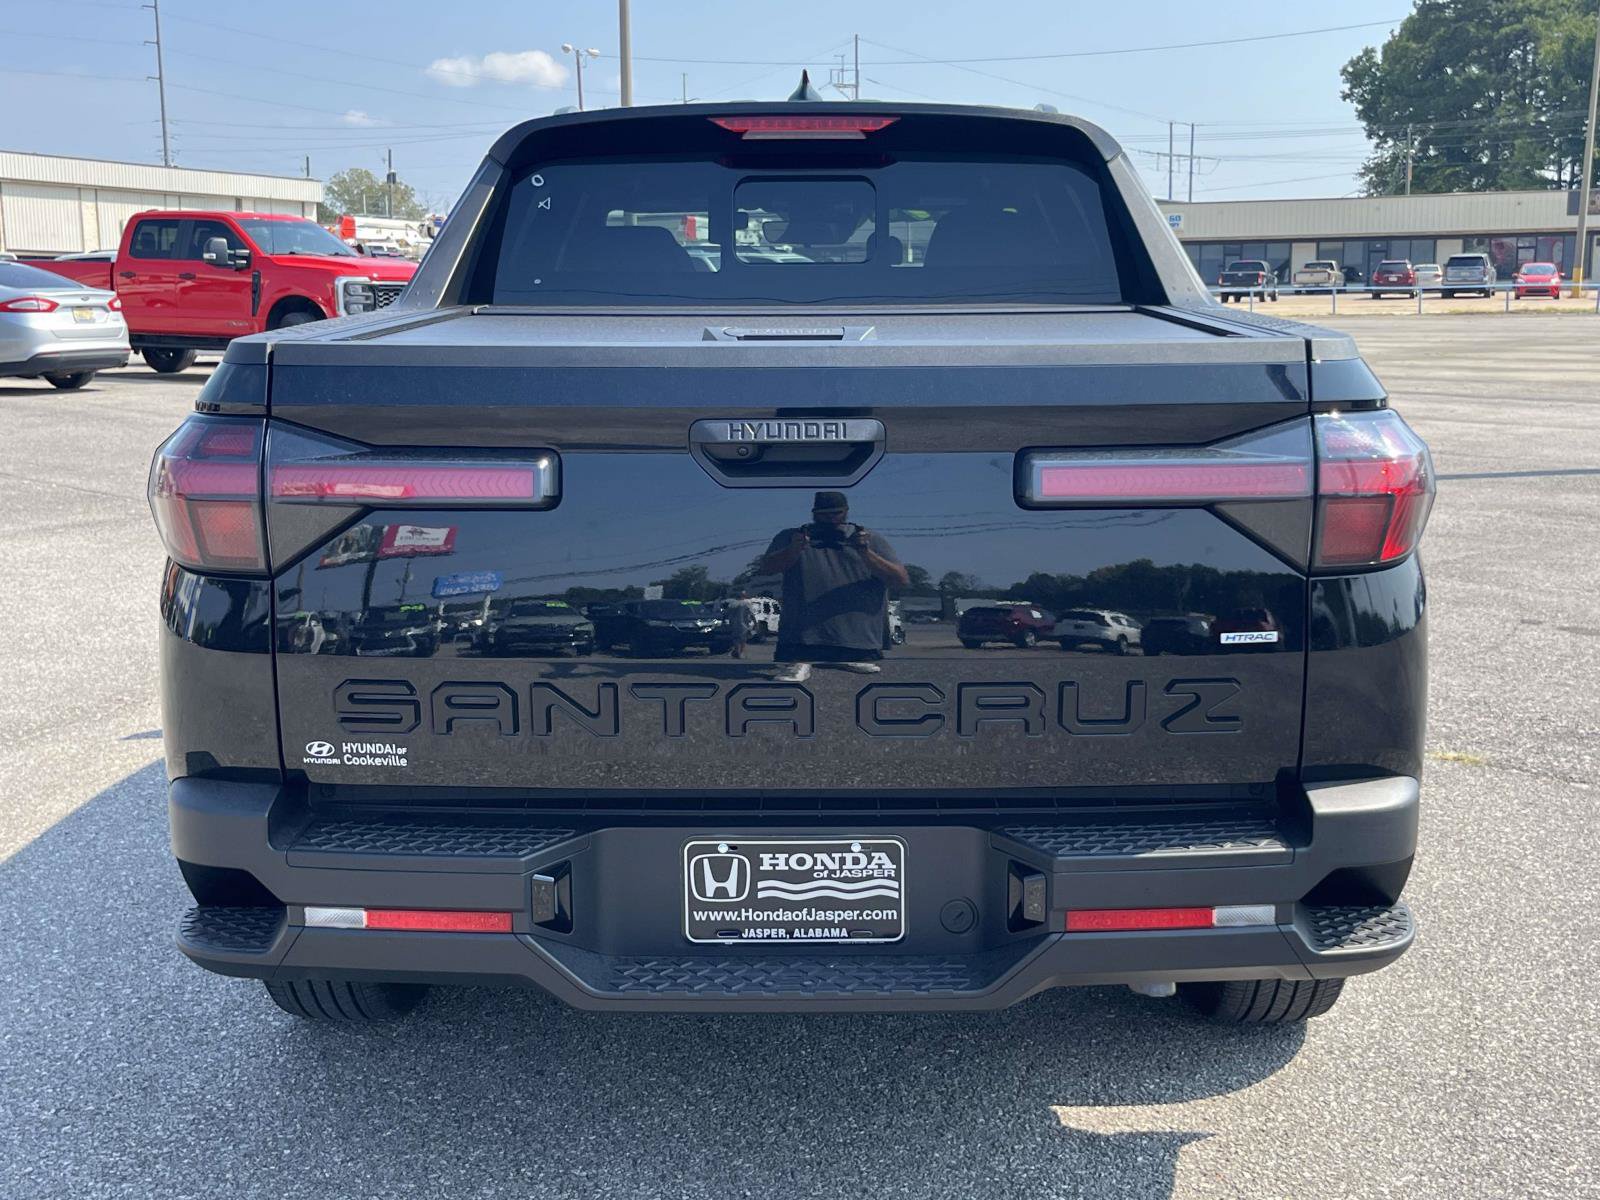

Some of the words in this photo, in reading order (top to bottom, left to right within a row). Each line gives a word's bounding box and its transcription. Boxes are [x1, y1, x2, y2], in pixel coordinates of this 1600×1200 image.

[728, 422, 847, 440] HYUNDAI
[1225, 633, 1274, 642] HTRAC
[333, 678, 817, 740] SANTA
[856, 677, 1243, 740] CRUZ
[342, 742, 396, 754] HYUNDAI
[303, 757, 341, 765] HYUNDAI
[343, 753, 408, 767] Cookeville
[759, 852, 897, 871] HONDA
[813, 870, 830, 878] of
[831, 869, 896, 878] JASPER
[693, 908, 899, 924] www.HondaofJasper.com
[741, 928, 791, 939] JASPER,
[792, 928, 849, 938] ALABAMA
